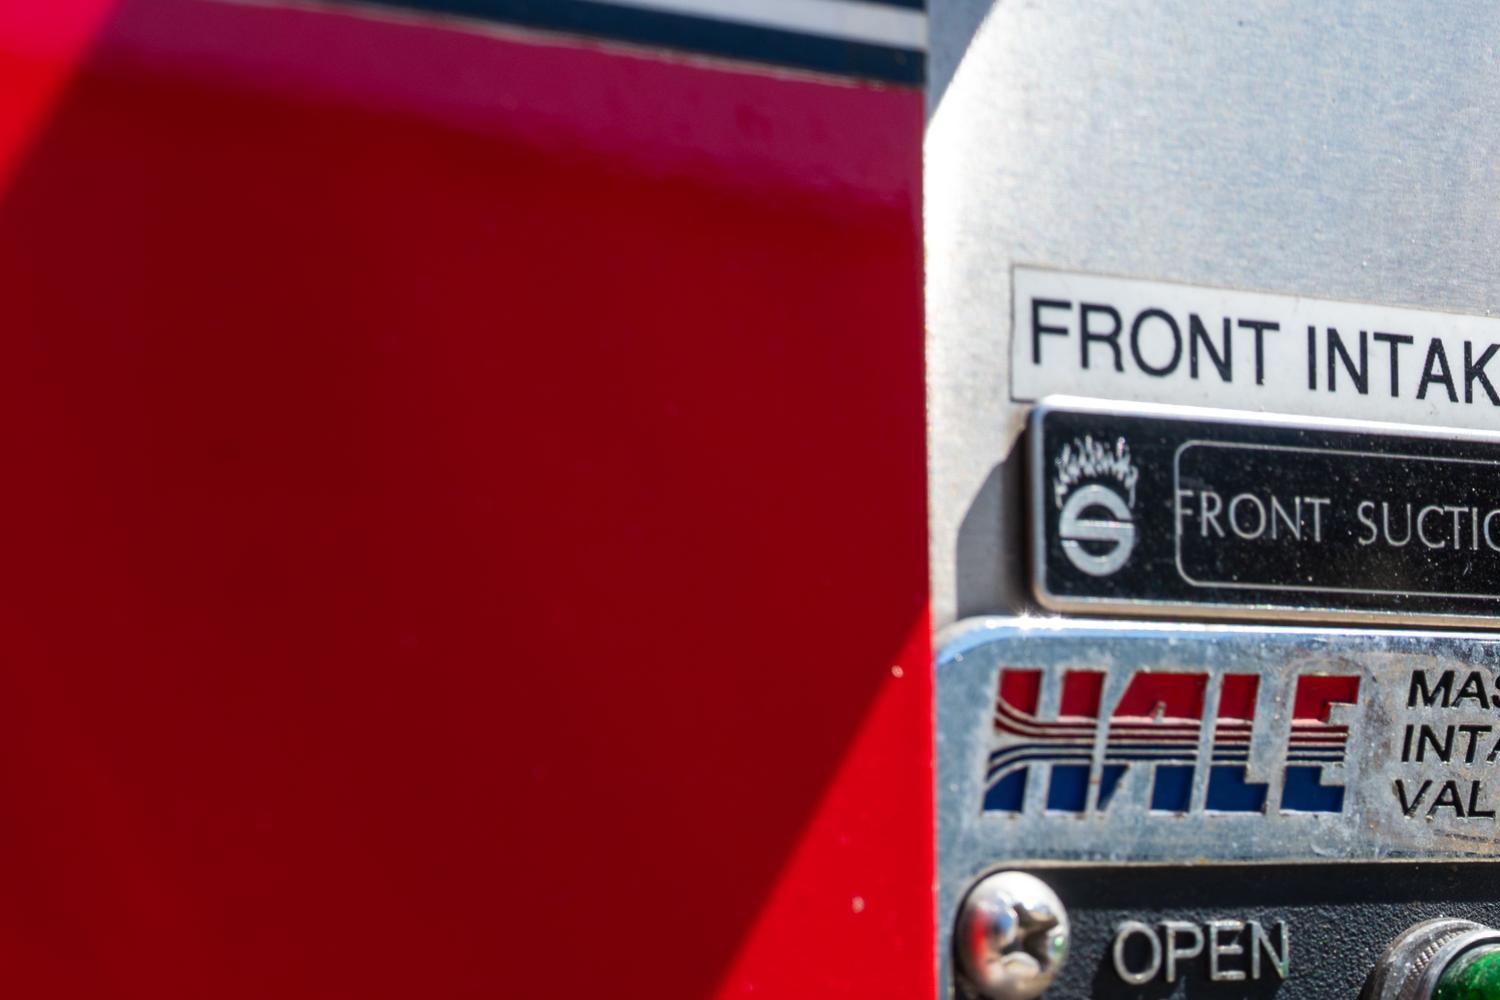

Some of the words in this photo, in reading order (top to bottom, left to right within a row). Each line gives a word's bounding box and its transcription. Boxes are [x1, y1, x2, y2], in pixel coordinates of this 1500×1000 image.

[1030, 297, 1280, 385] FRONT
[1175, 489, 1331, 543] FRONT
[983, 667, 1362, 815] HALE
[1112, 919, 1291, 985] OPEN
